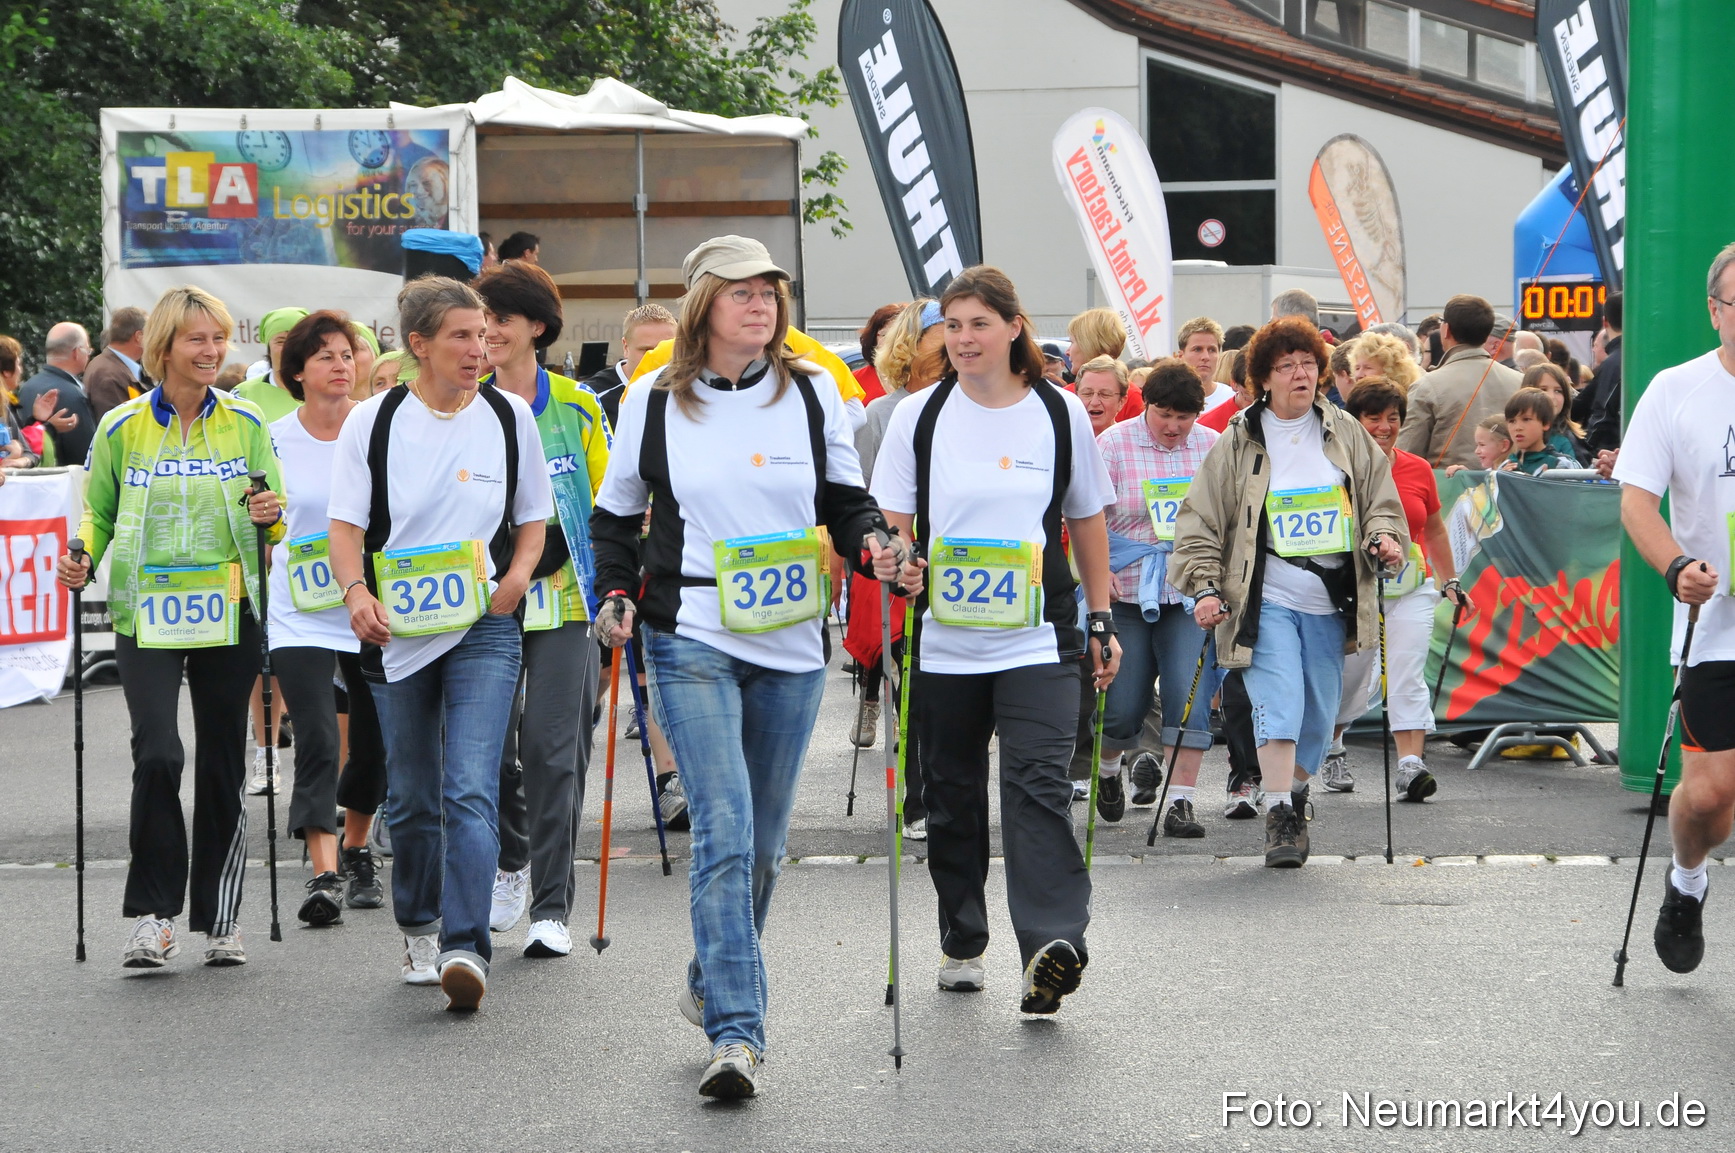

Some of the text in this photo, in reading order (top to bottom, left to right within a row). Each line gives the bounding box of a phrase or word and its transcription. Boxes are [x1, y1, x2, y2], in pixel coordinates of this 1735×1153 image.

[130, 165, 255, 205] TLA
[273, 184, 416, 228] Logistics
[124, 220, 163, 232] Transport
[195, 221, 228, 232] Agentur
[346, 222, 365, 236] for
[367, 224, 396, 240] your
[1273, 509, 1339, 539] 1267
[1285, 539, 1316, 547] Elisabeth
[391, 564, 426, 575] firmenlauf
[391, 573, 466, 615] 320
[731, 563, 808, 610] 328
[941, 567, 1018, 606] 324
[312, 589, 338, 600] Carina
[140, 592, 225, 626] 1050
[752, 609, 773, 619] Inge
[952, 604, 986, 614] Claudia
[403, 612, 439, 624] Barbara
[158, 627, 196, 637] Gottfried
